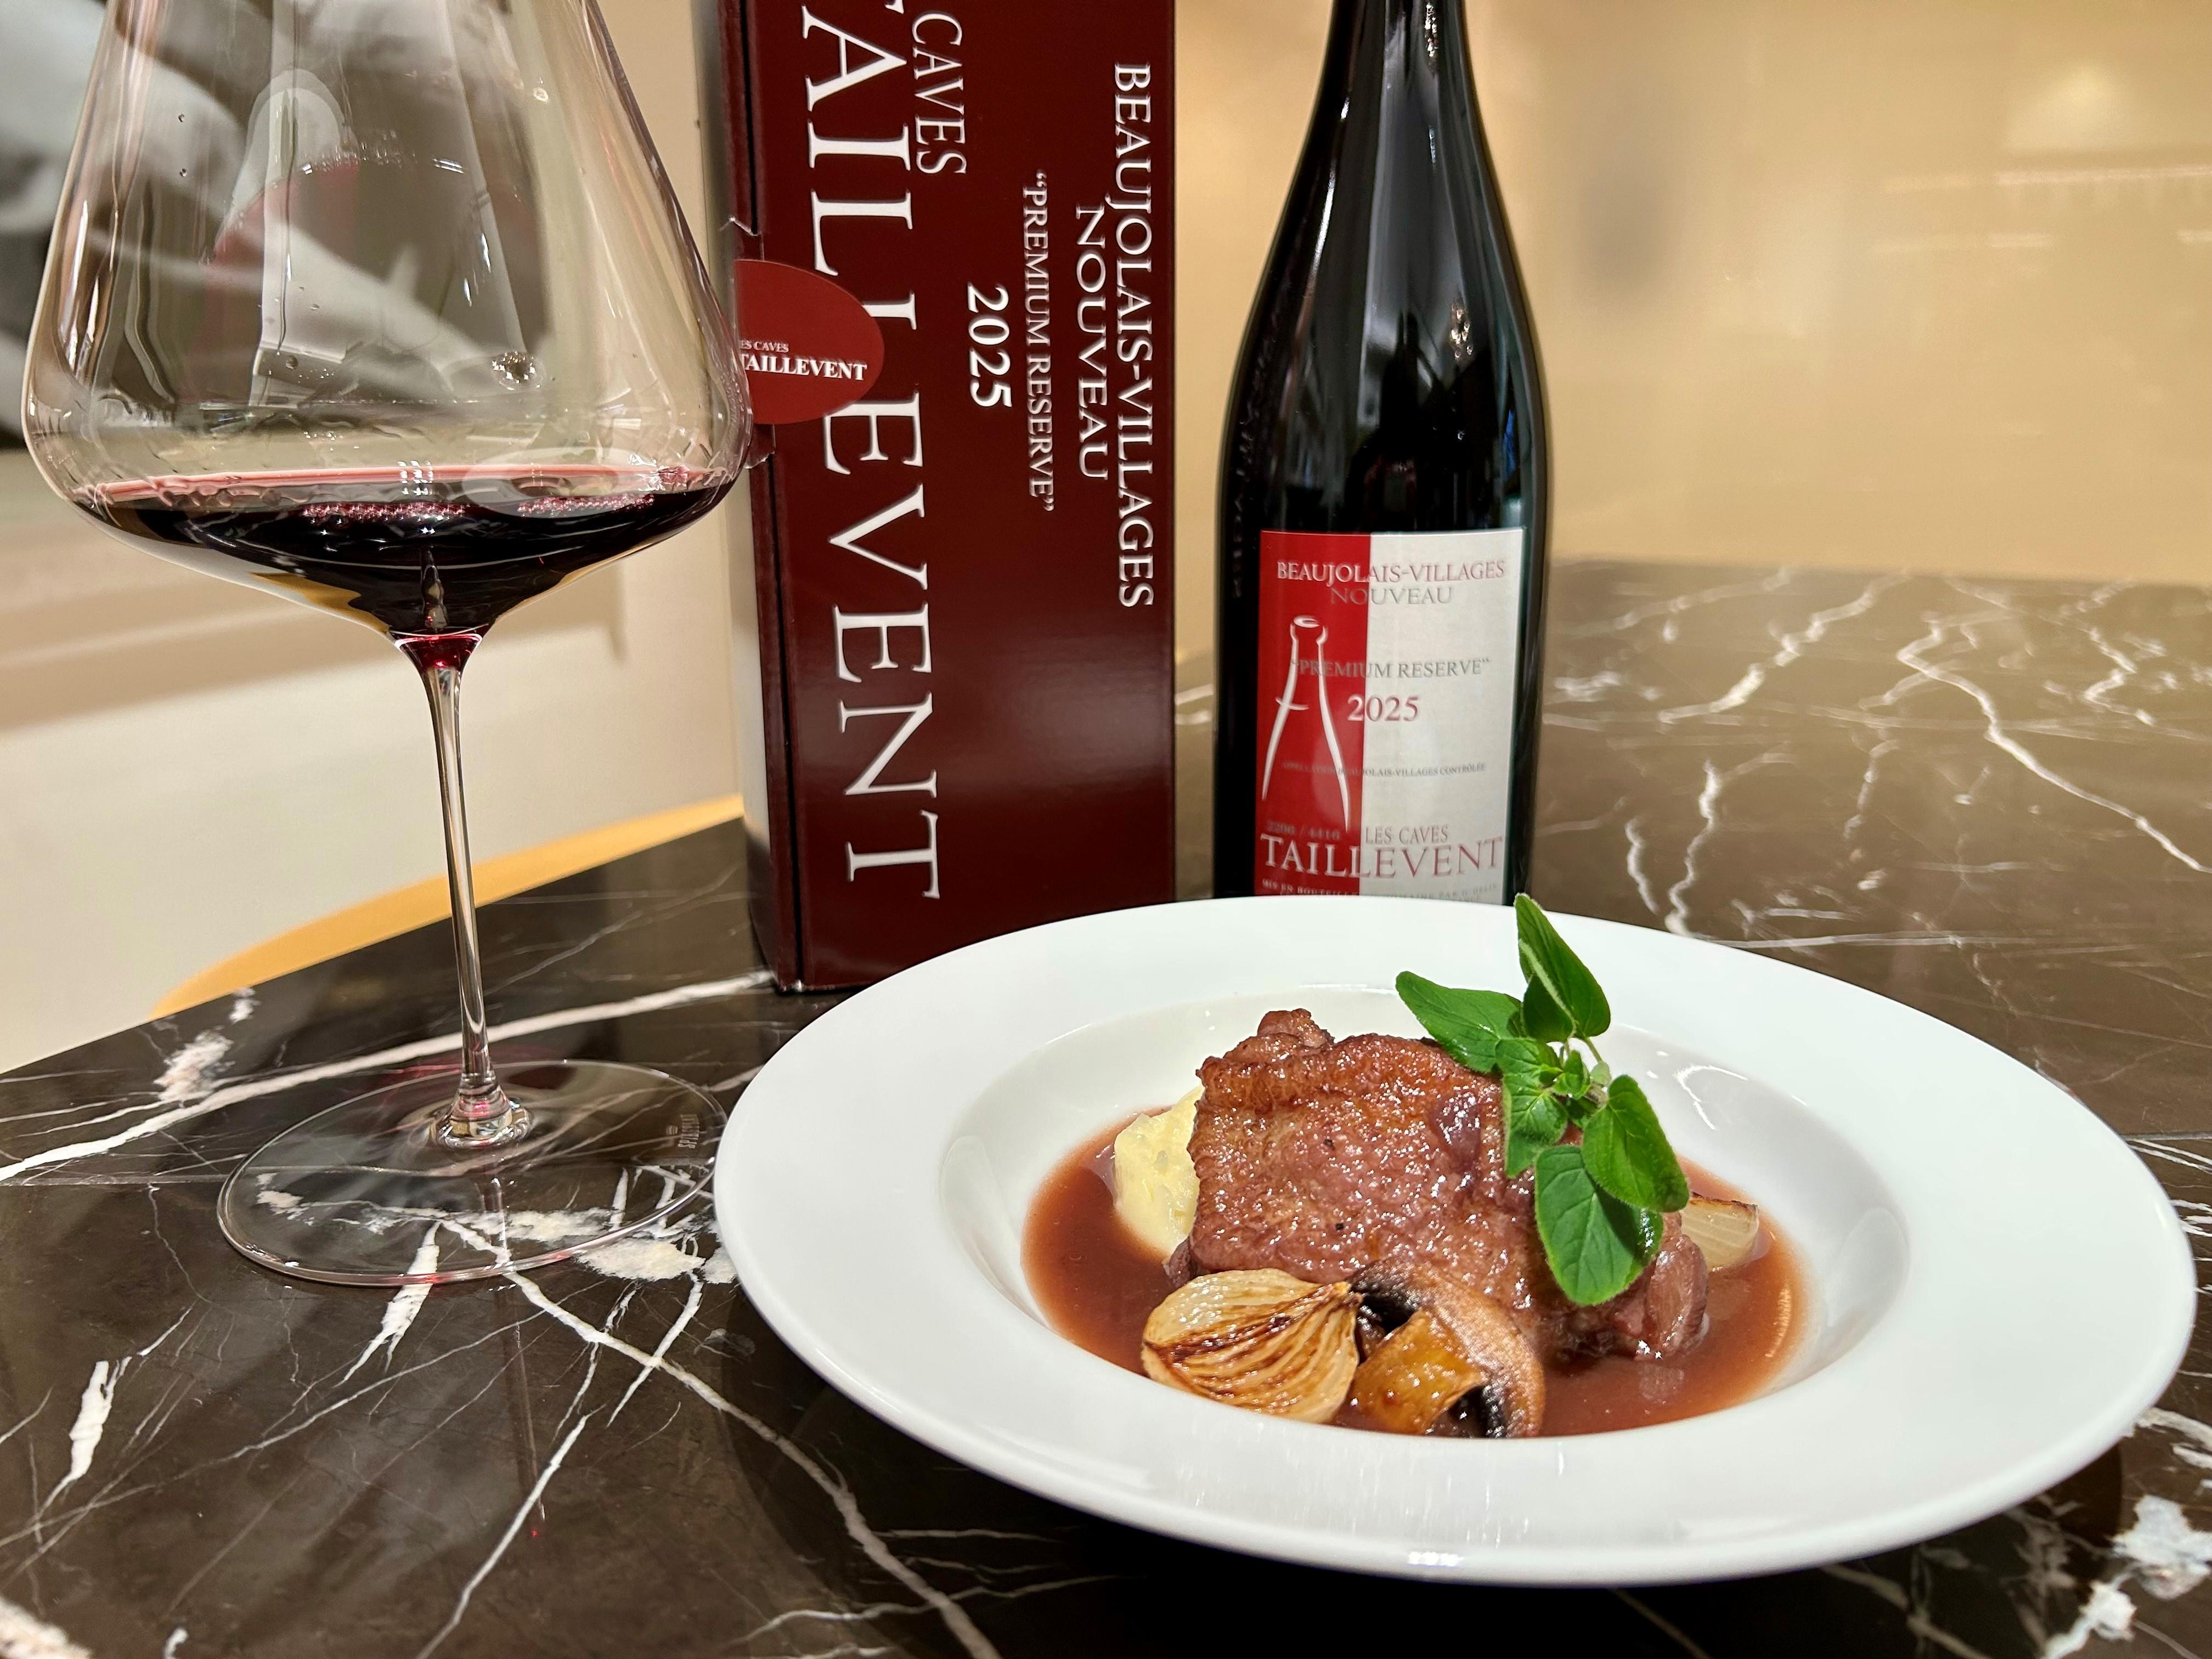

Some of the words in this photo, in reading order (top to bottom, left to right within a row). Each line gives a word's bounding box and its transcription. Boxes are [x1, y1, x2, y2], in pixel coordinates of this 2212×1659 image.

[911, 13, 967, 174] CAVES
[738, 339, 752, 350] ES
[753, 341, 789, 353] CAVES
[967, 282, 1012, 408] 2025
[1075, 204, 1108, 480] NOUVEAU
[1105, 61, 1154, 607] BEAUJOLAIS-VILLAGES
[801, 0, 940, 899] AILEVENT
[1277, 560, 1505, 586] BEAUJOLAIS-VILLAGES
[1330, 586, 1454, 605] NOUVEAU
[1347, 695, 1419, 722] 2025
[1365, 826, 1392, 844] LES
[1398, 825, 1448, 844] CAVES
[1260, 835, 1502, 878] TAILLEVENT
